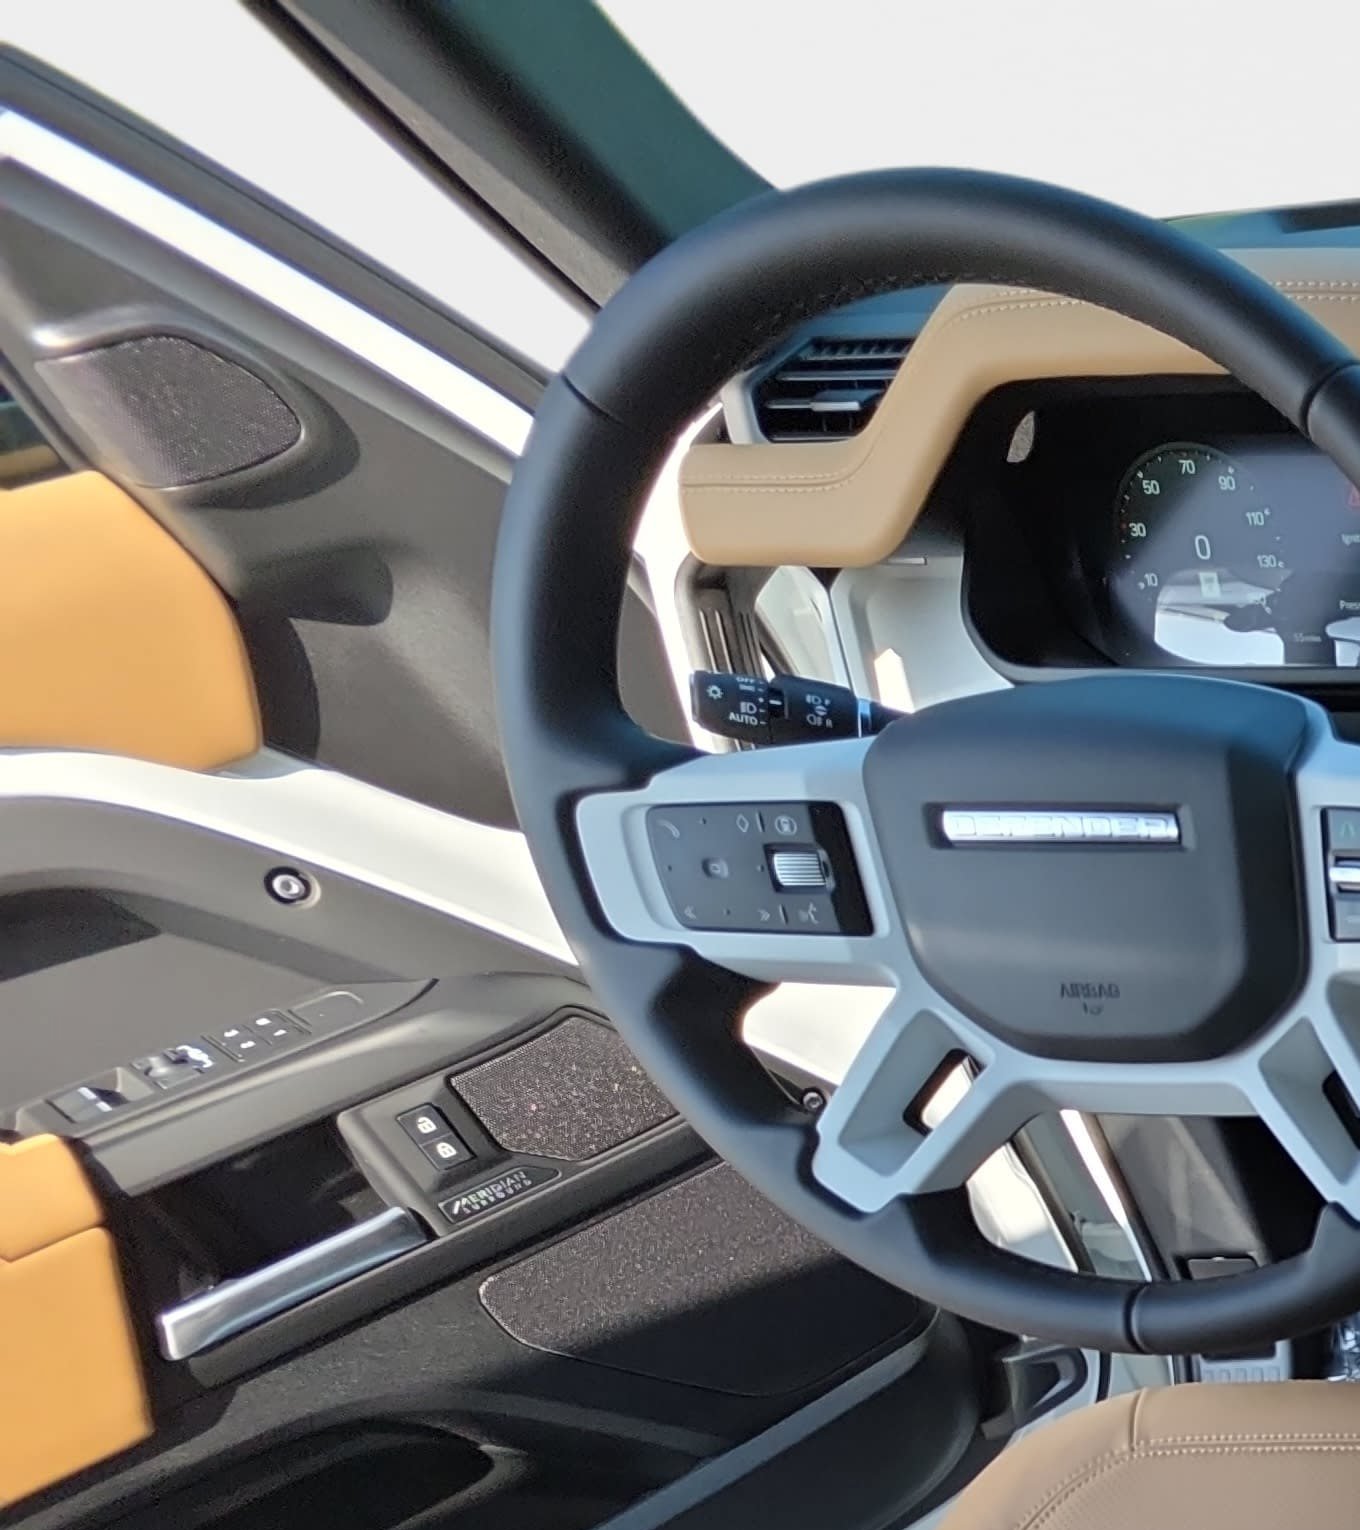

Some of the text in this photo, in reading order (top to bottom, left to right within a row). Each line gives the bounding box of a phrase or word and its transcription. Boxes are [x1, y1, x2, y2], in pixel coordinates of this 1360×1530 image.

[1178, 459, 1196, 475] 70
[1142, 480, 1161, 495] 50
[1218, 476, 1236, 491] 90
[1245, 511, 1265, 526] 110
[1128, 523, 1147, 538] 30
[1194, 534, 1212, 560] 0
[1256, 555, 1277, 568] 130
[1143, 573, 1159, 587] 10
[728, 711, 759, 727] AUTO
[951, 814, 1171, 839] DEFENDER
[1059, 982, 1121, 1000] AIRBAG
[452, 1170, 527, 1215] MERIDIAN
